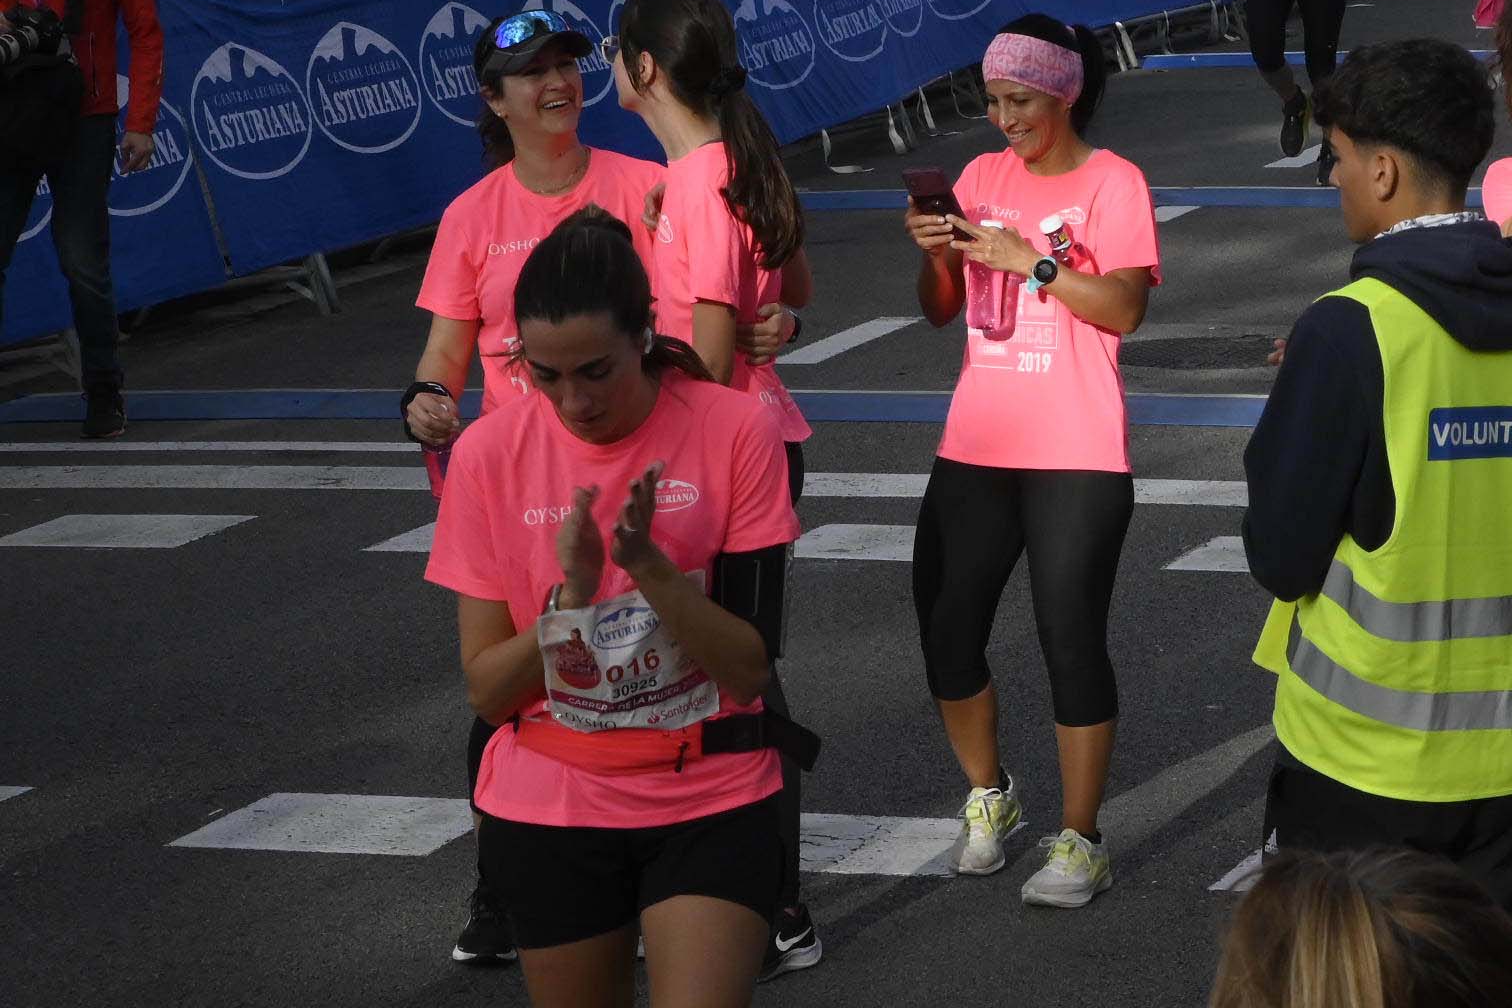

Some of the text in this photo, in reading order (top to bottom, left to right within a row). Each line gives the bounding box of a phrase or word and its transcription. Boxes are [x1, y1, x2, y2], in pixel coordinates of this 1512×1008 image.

[316, 76, 418, 127] ASTURIANA
[201, 98, 307, 152] ASTURIANA
[1017, 352, 1052, 374] 2019
[597, 614, 659, 643] ASTURIANA
[605, 648, 661, 685] 016
[612, 676, 658, 700] 30925
